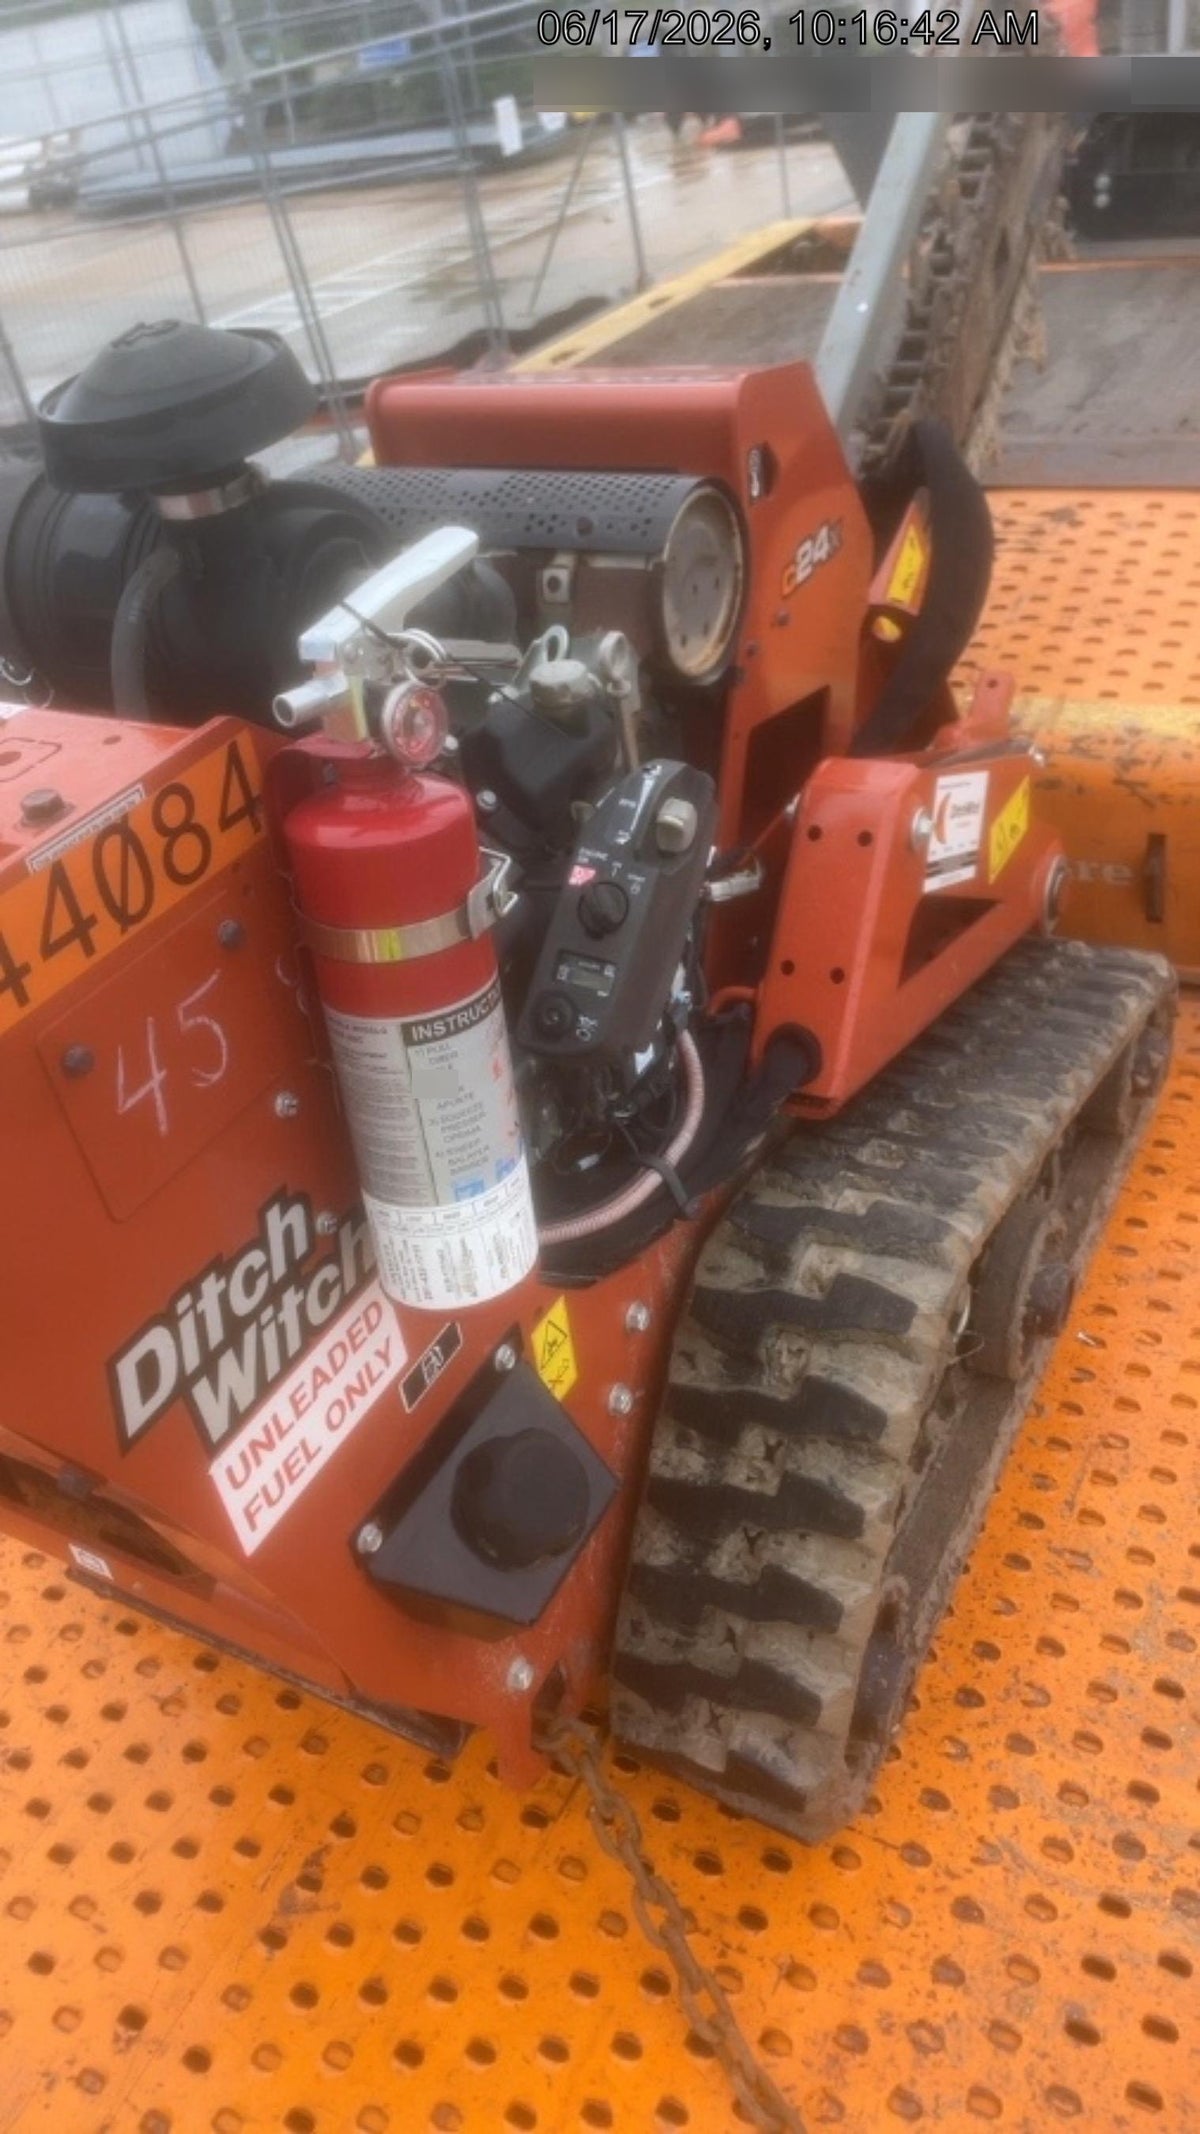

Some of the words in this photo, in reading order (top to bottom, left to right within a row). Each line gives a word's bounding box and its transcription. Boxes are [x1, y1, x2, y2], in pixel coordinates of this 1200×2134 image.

[114, 1199, 310, 1441] Ditch
[190, 1218, 378, 1444] Witch
[224, 1299, 383, 1491] UNLEADED
[242, 1438, 322, 1532] FUEL
[324, 1336, 393, 1433] ONLY
